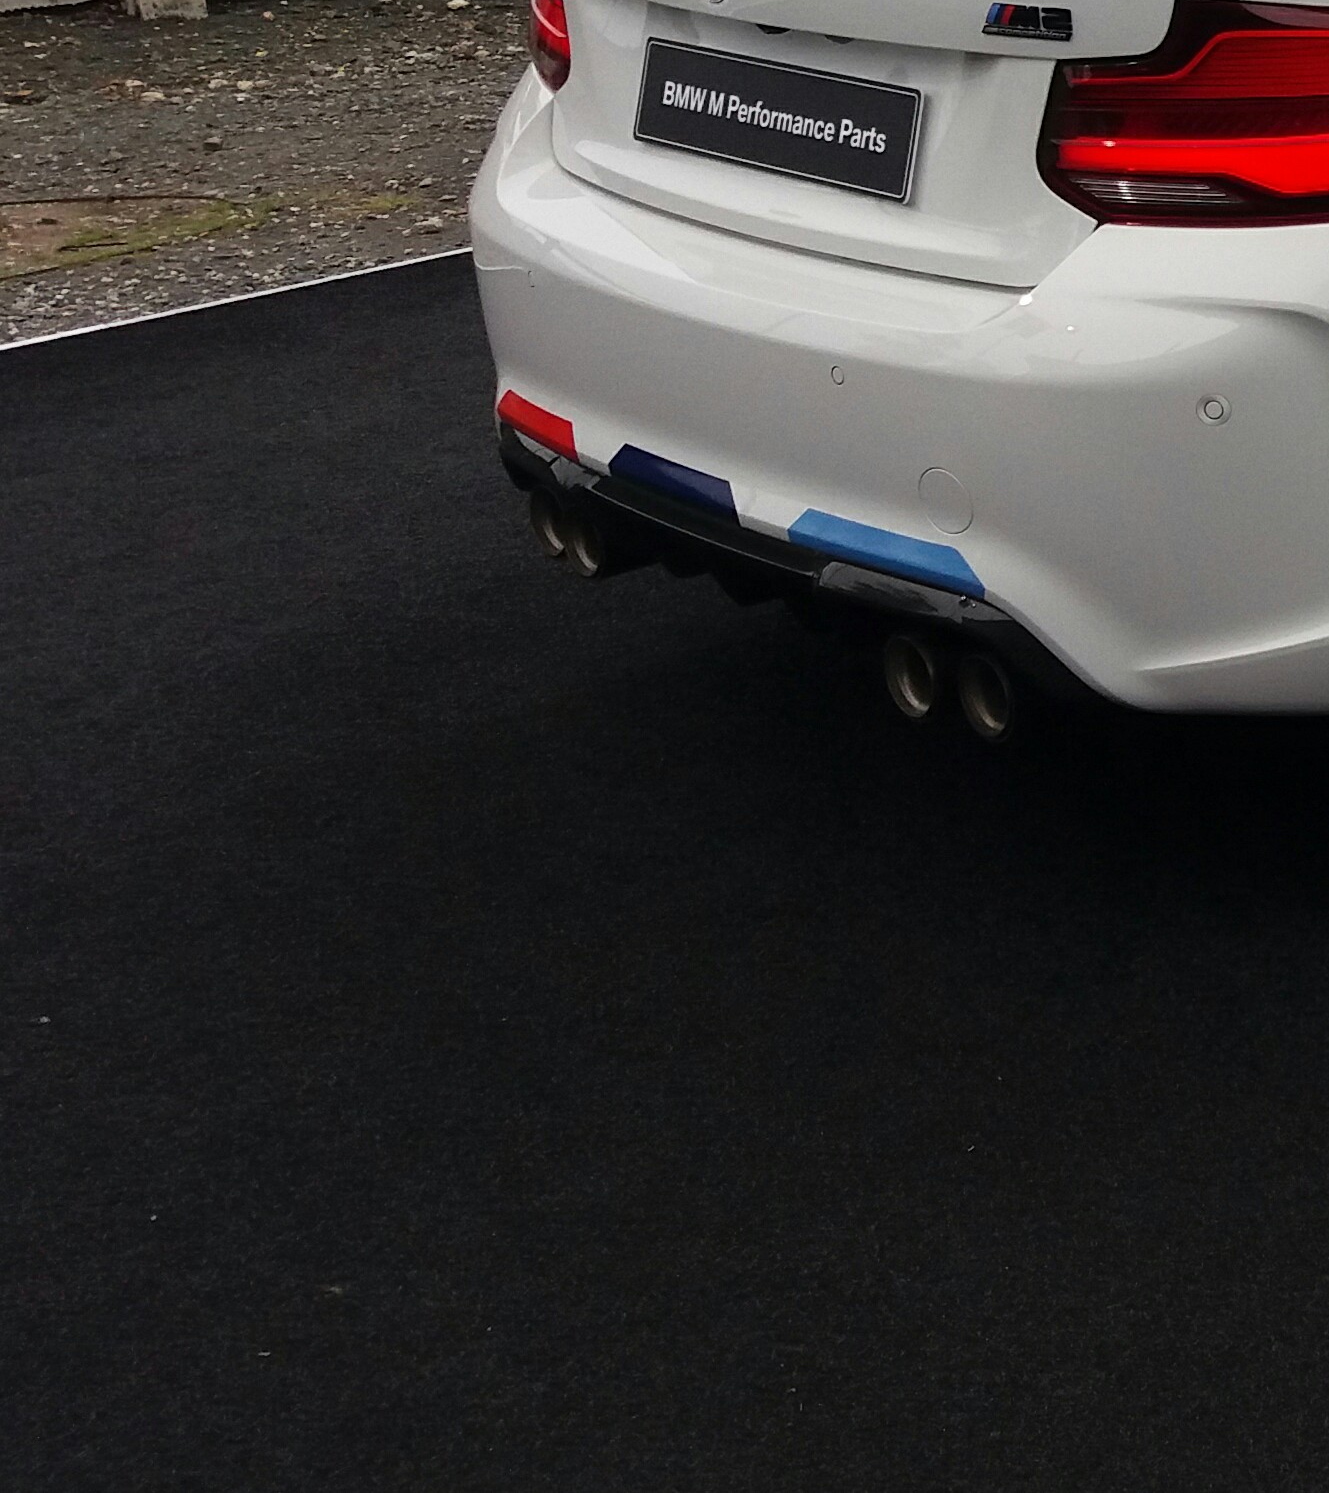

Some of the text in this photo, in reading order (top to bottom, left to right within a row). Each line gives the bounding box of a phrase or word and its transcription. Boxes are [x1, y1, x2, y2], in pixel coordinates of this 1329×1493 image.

[662, 80, 887, 154] BMW M Performance Parts
